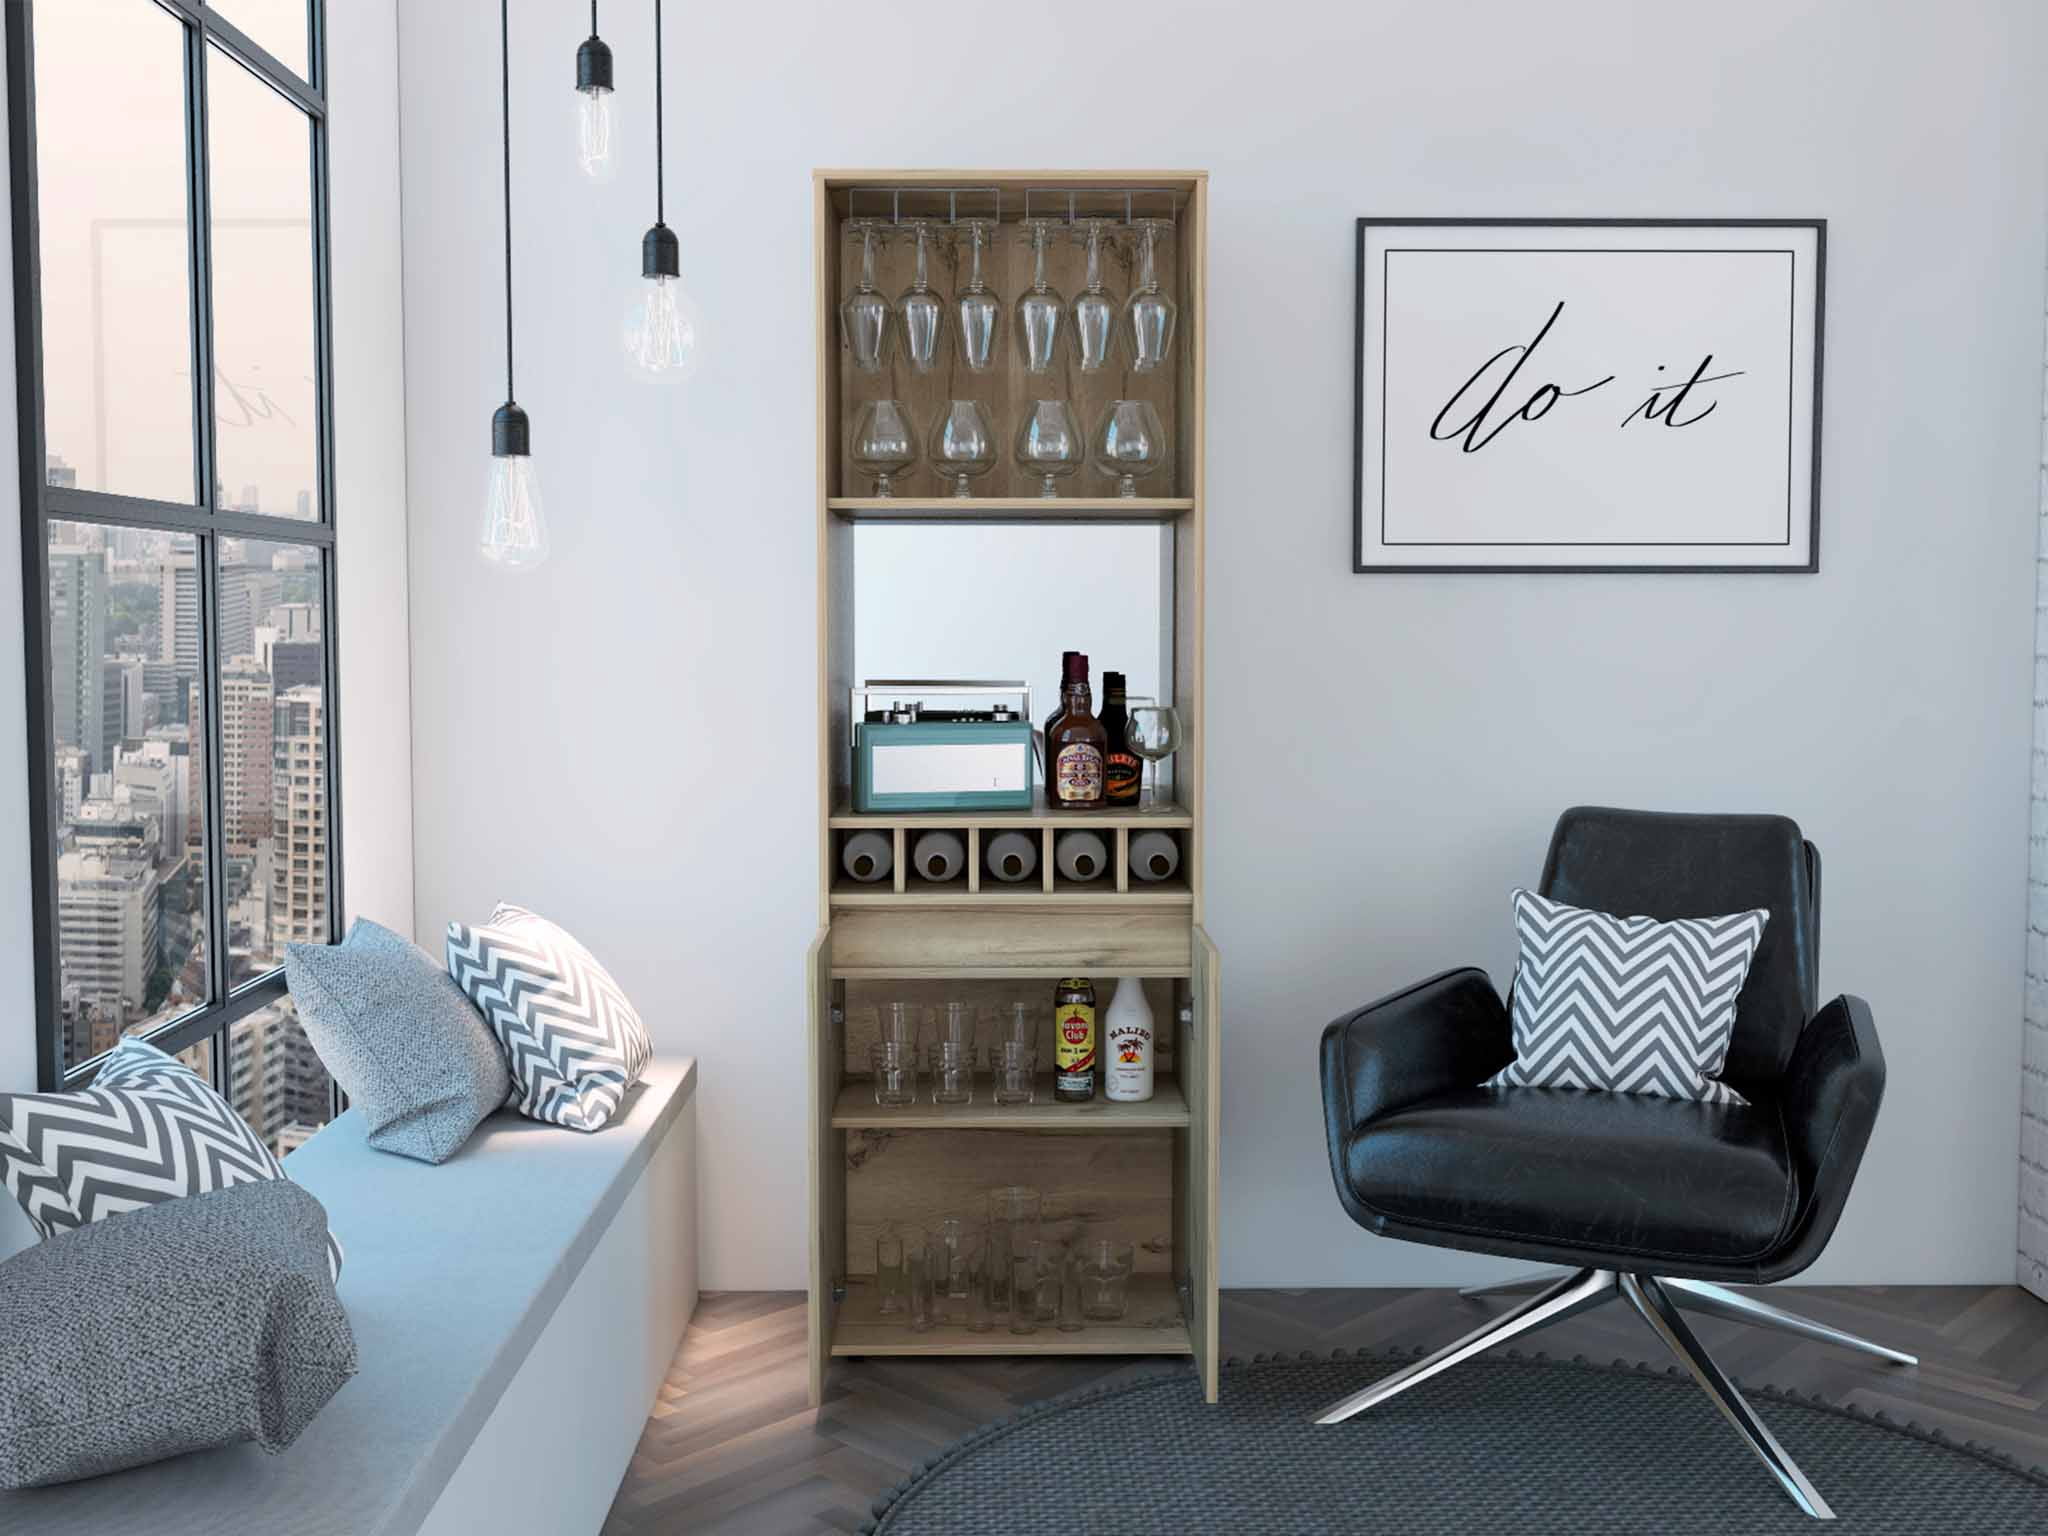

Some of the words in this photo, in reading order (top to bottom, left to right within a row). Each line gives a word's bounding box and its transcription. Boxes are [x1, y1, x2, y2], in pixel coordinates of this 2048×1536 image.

[1429, 301, 1615, 453] do
[1621, 354, 1745, 428] it
[1065, 1030, 1085, 1041] Club
